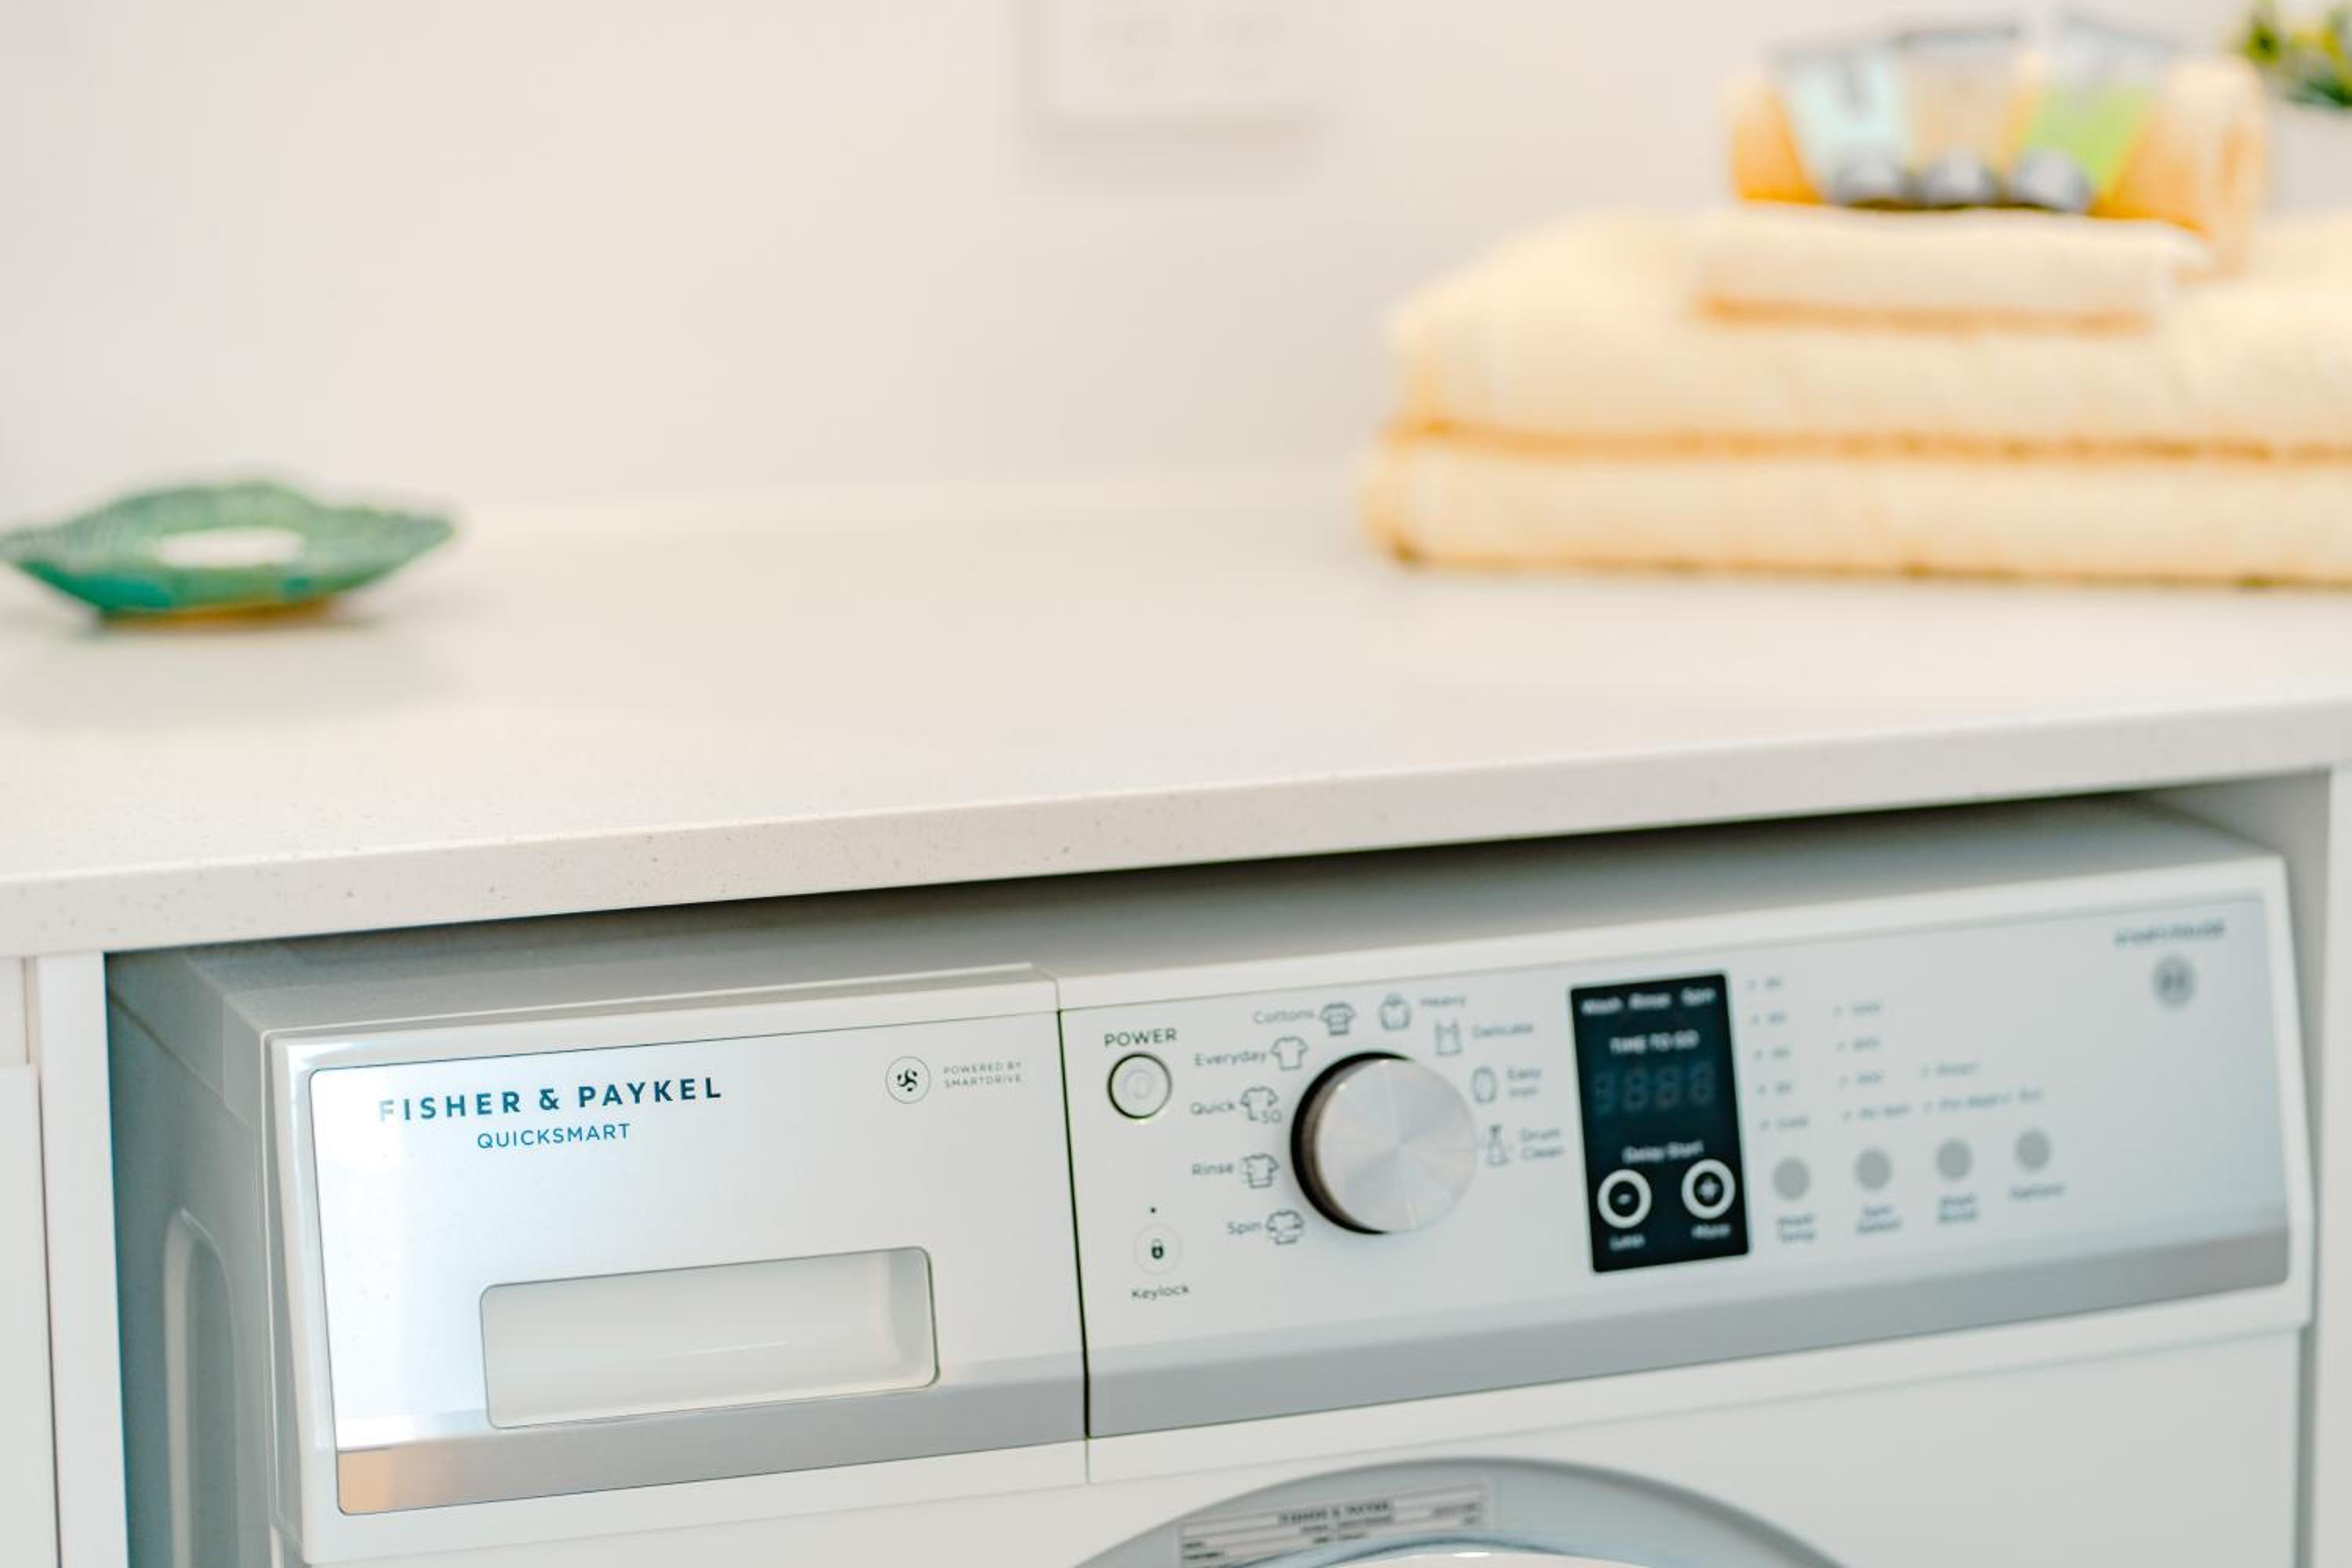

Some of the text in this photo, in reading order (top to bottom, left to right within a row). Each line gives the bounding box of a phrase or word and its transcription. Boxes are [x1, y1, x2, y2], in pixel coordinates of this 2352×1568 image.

[1254, 1009, 1316, 1024] Cottons
[1104, 1027, 1178, 1047] POWER
[1194, 1051, 1267, 1067] Everyday
[943, 1060, 1022, 1075] POWERED BY
[379, 1076, 722, 1122] FISHER & PAYKEL
[1190, 1101, 1236, 1115] Quick
[1261, 1109, 1283, 1123] 30
[477, 1123, 630, 1149] QUICKSMART
[1192, 1163, 1234, 1176] Rinse
[1227, 1221, 1261, 1236] Spin
[1131, 1283, 1189, 1301] Keylock
